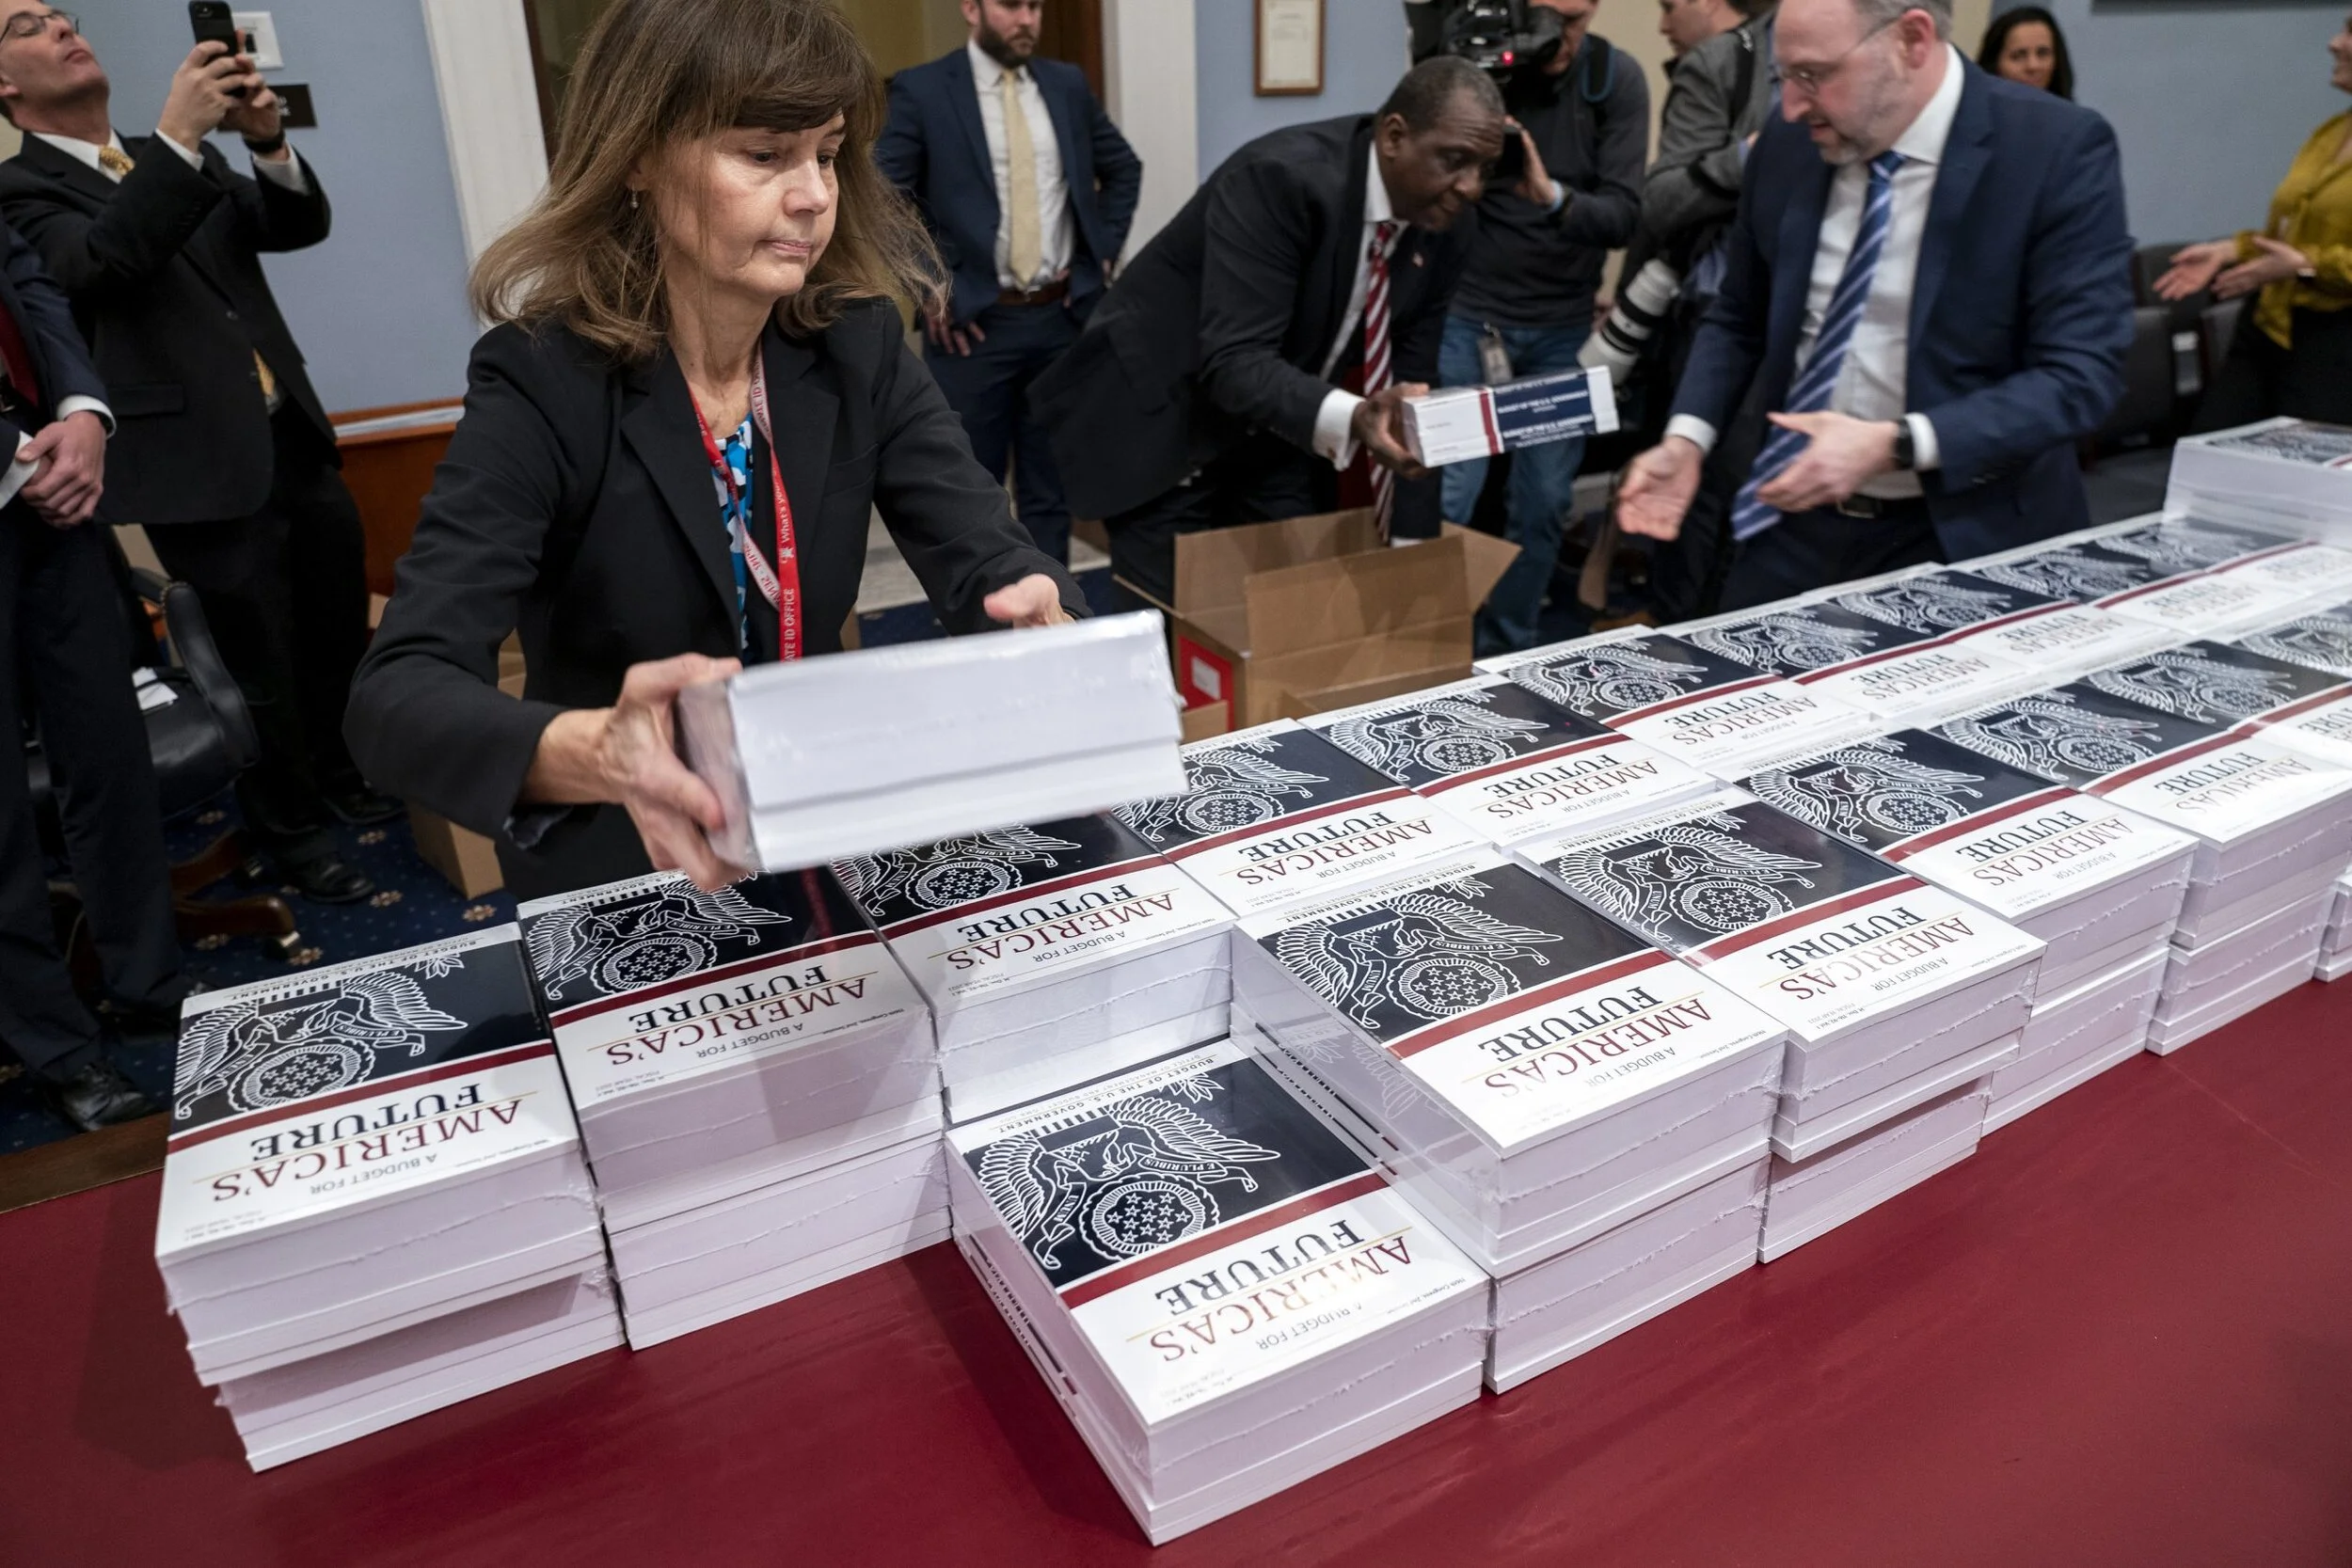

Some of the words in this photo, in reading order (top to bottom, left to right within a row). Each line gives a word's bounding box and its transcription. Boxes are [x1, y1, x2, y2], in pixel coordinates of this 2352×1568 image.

[780, 506, 790, 544] What's
[784, 588, 796, 628] OFFICE
[784, 628, 796, 641] ID
[1851, 655, 1953, 688] FUTURE
[1664, 691, 1780, 729] FUTURE
[1673, 696, 1819, 746] AMERICA'S
[1483, 754, 1621, 799] FUTURE
[2154, 752, 2266, 797] FUTURE
[1486, 760, 1659, 819] AMERICA'S
[1238, 811, 1397, 863] FUTURE
[1955, 810, 2089, 863] FUTURE
[1235, 819, 1432, 885] AMERICA'S
[1342, 853, 1388, 873] BUDGET
[1974, 817, 2134, 886] AMERICA'S
[1315, 866, 1341, 879] FOR
[1435, 864, 1476, 880] BUDGET
[1706, 866, 1760, 876] PLURIBUS
[563, 882, 645, 905] GOVERNMENT
[1391, 882, 1412, 893] THE
[957, 883, 1138, 942] FUTURE
[1285, 897, 1362, 923] GOVERNMENT
[946, 893, 1174, 970] AMERICA'S
[1061, 933, 1115, 955] BUDGET
[1767, 906, 1927, 970] FUTURE
[1032, 949, 1058, 963] FOR
[1435, 941, 1493, 951] PLURIBUS
[1778, 917, 1975, 1000] AMERICA'S
[370, 959, 395, 969] THE
[1899, 959, 1938, 982] BUDGET
[1938, 956, 1948, 965] A
[230, 974, 328, 1001] GOVERNMENT
[1361, 969, 1381, 992] UNUM
[1869, 976, 1896, 991] FOR
[628, 965, 832, 1033] FUTURE
[606, 977, 866, 1066] AMERICA'S
[793, 1022, 803, 1032] A
[1478, 986, 1663, 1063] FUTURE
[696, 1044, 726, 1058] FOR
[730, 1027, 790, 1049] BUDGET
[1484, 998, 1713, 1099] AMERICA'S
[1665, 1046, 1676, 1055] A
[1166, 1057, 1214, 1078] BUDGET
[1613, 1050, 1664, 1077] BUDGET
[1117, 1082, 1144, 1095] THE
[1146, 1074, 1163, 1085] OF
[1583, 1069, 1612, 1087] FOR
[249, 1083, 482, 1163] FUTURE
[997, 1101, 1085, 1133] GOVERNMENT
[211, 1099, 523, 1201] AMERICA'S
[425, 1153, 437, 1164] A
[349, 1157, 421, 1184] BUDGET
[1143, 1158, 1202, 1171] PLURIBUS
[310, 1178, 344, 1195] FOR
[1053, 1195, 1080, 1224] UNUM
[1153, 1219, 1366, 1316] FUTURE
[1254, 1326, 1288, 1352] FOR
